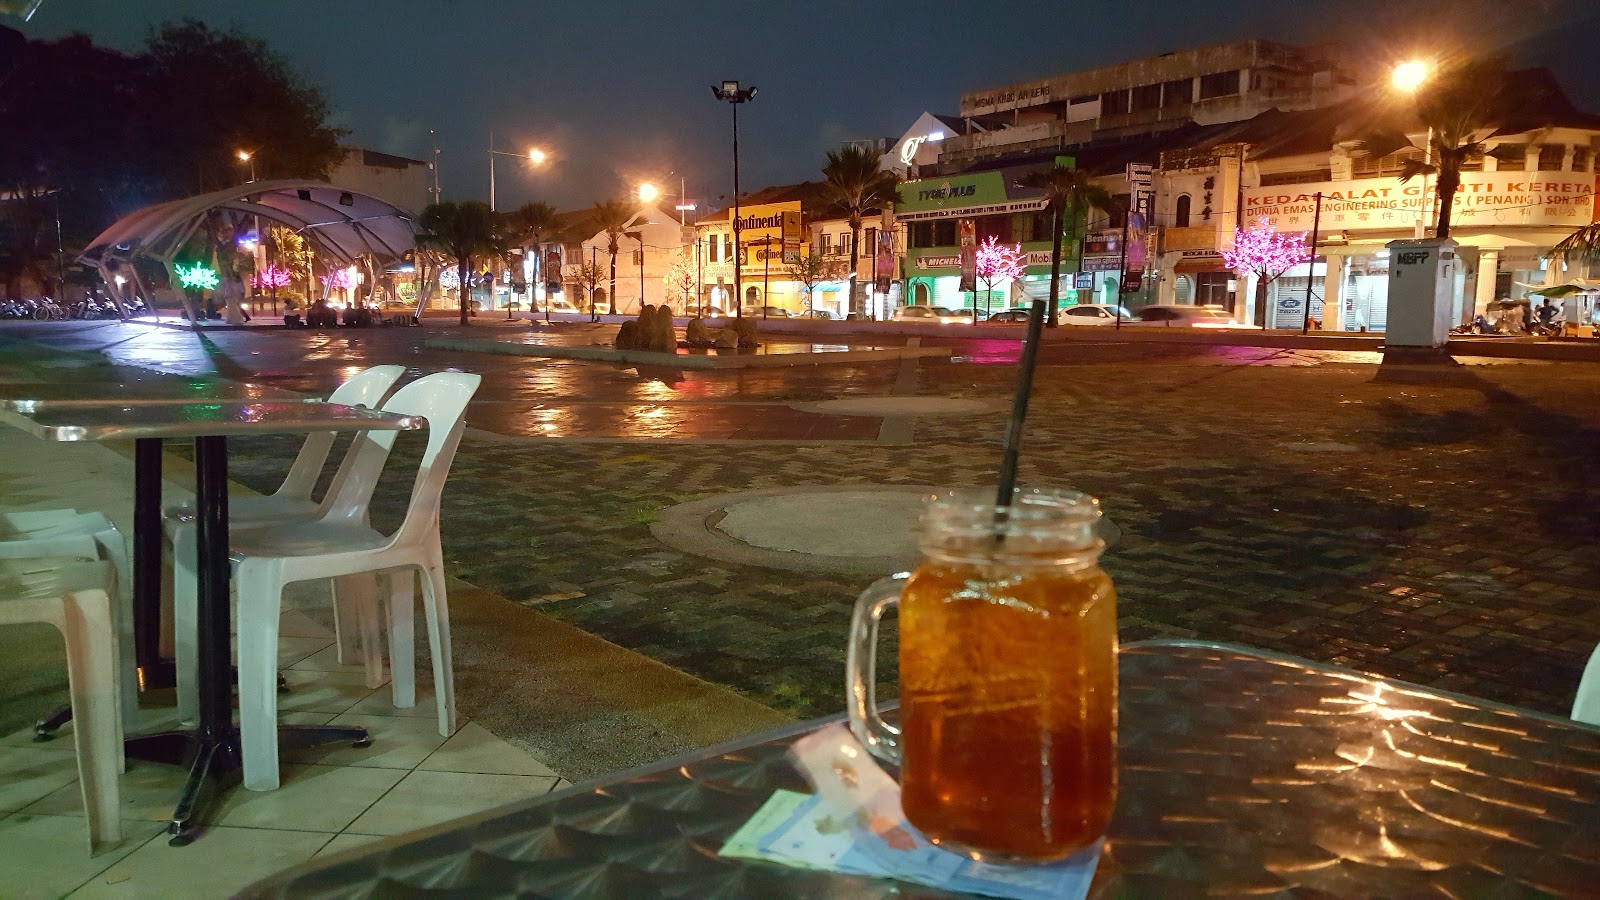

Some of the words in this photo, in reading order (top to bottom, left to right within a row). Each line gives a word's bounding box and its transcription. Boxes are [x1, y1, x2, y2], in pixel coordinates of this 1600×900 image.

[1330, 188, 1392, 200] ALAT
[1507, 182, 1592, 194] KERETA
[1247, 206, 1280, 217] DUNIA
[1283, 205, 1314, 215] EMAS
[1319, 199, 1397, 212] ENGINEERING
[1476, 195, 1533, 205] PENANG
[732, 212, 781, 233] Continenta
[1397, 251, 1429, 265] MBPP
